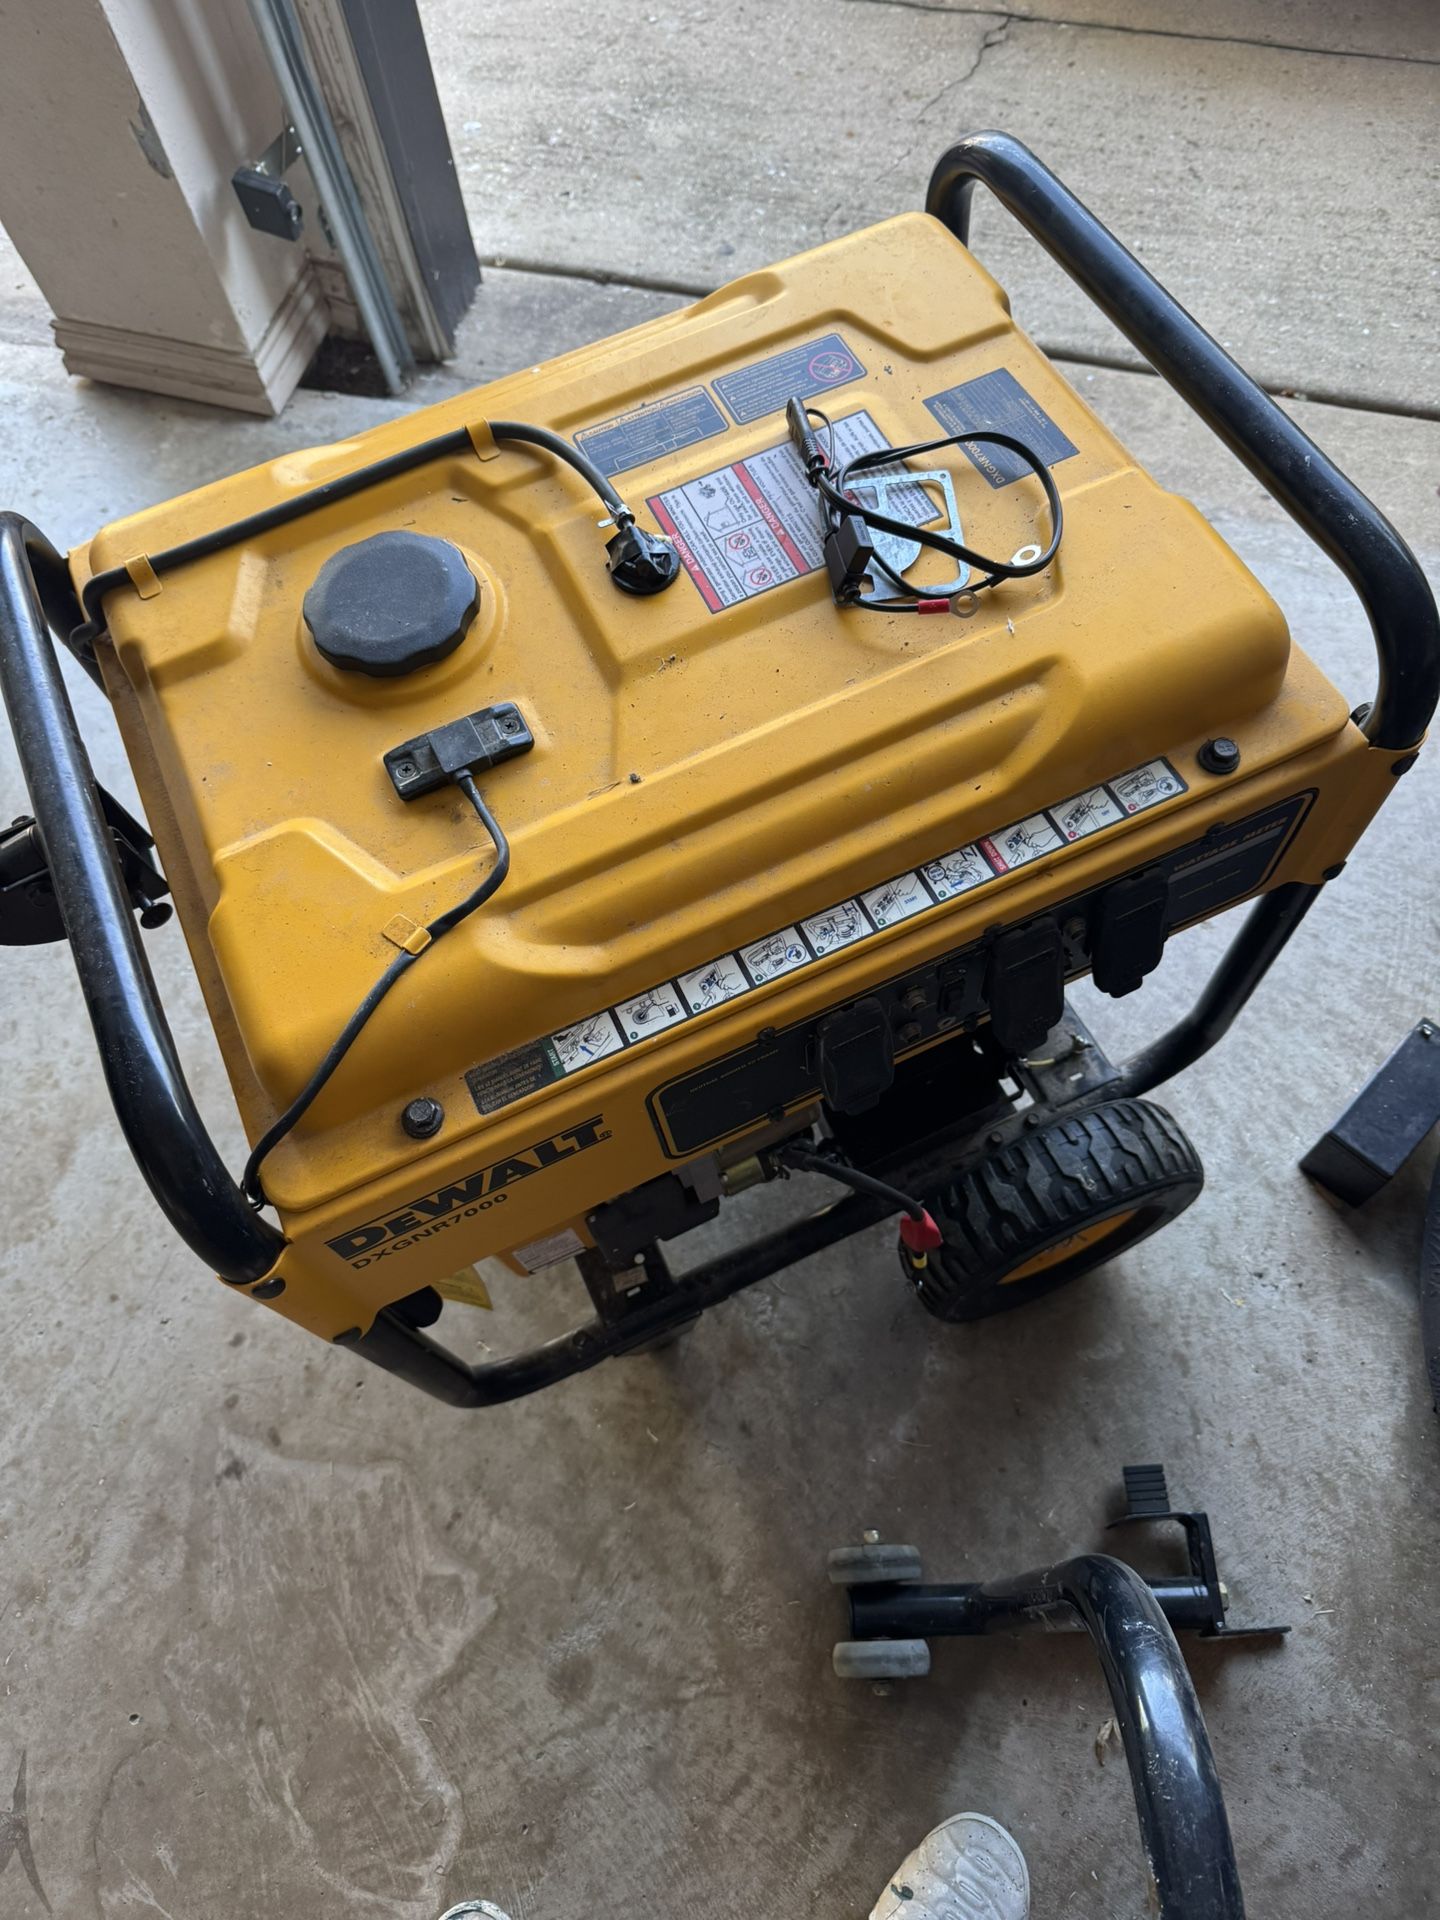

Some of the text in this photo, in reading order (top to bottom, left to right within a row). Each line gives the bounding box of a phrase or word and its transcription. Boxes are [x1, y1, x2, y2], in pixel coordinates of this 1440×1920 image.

[546, 1048, 560, 1067] START
[325, 1115, 606, 1261] DEWALT
[351, 1192, 508, 1270] DXGNR7000
